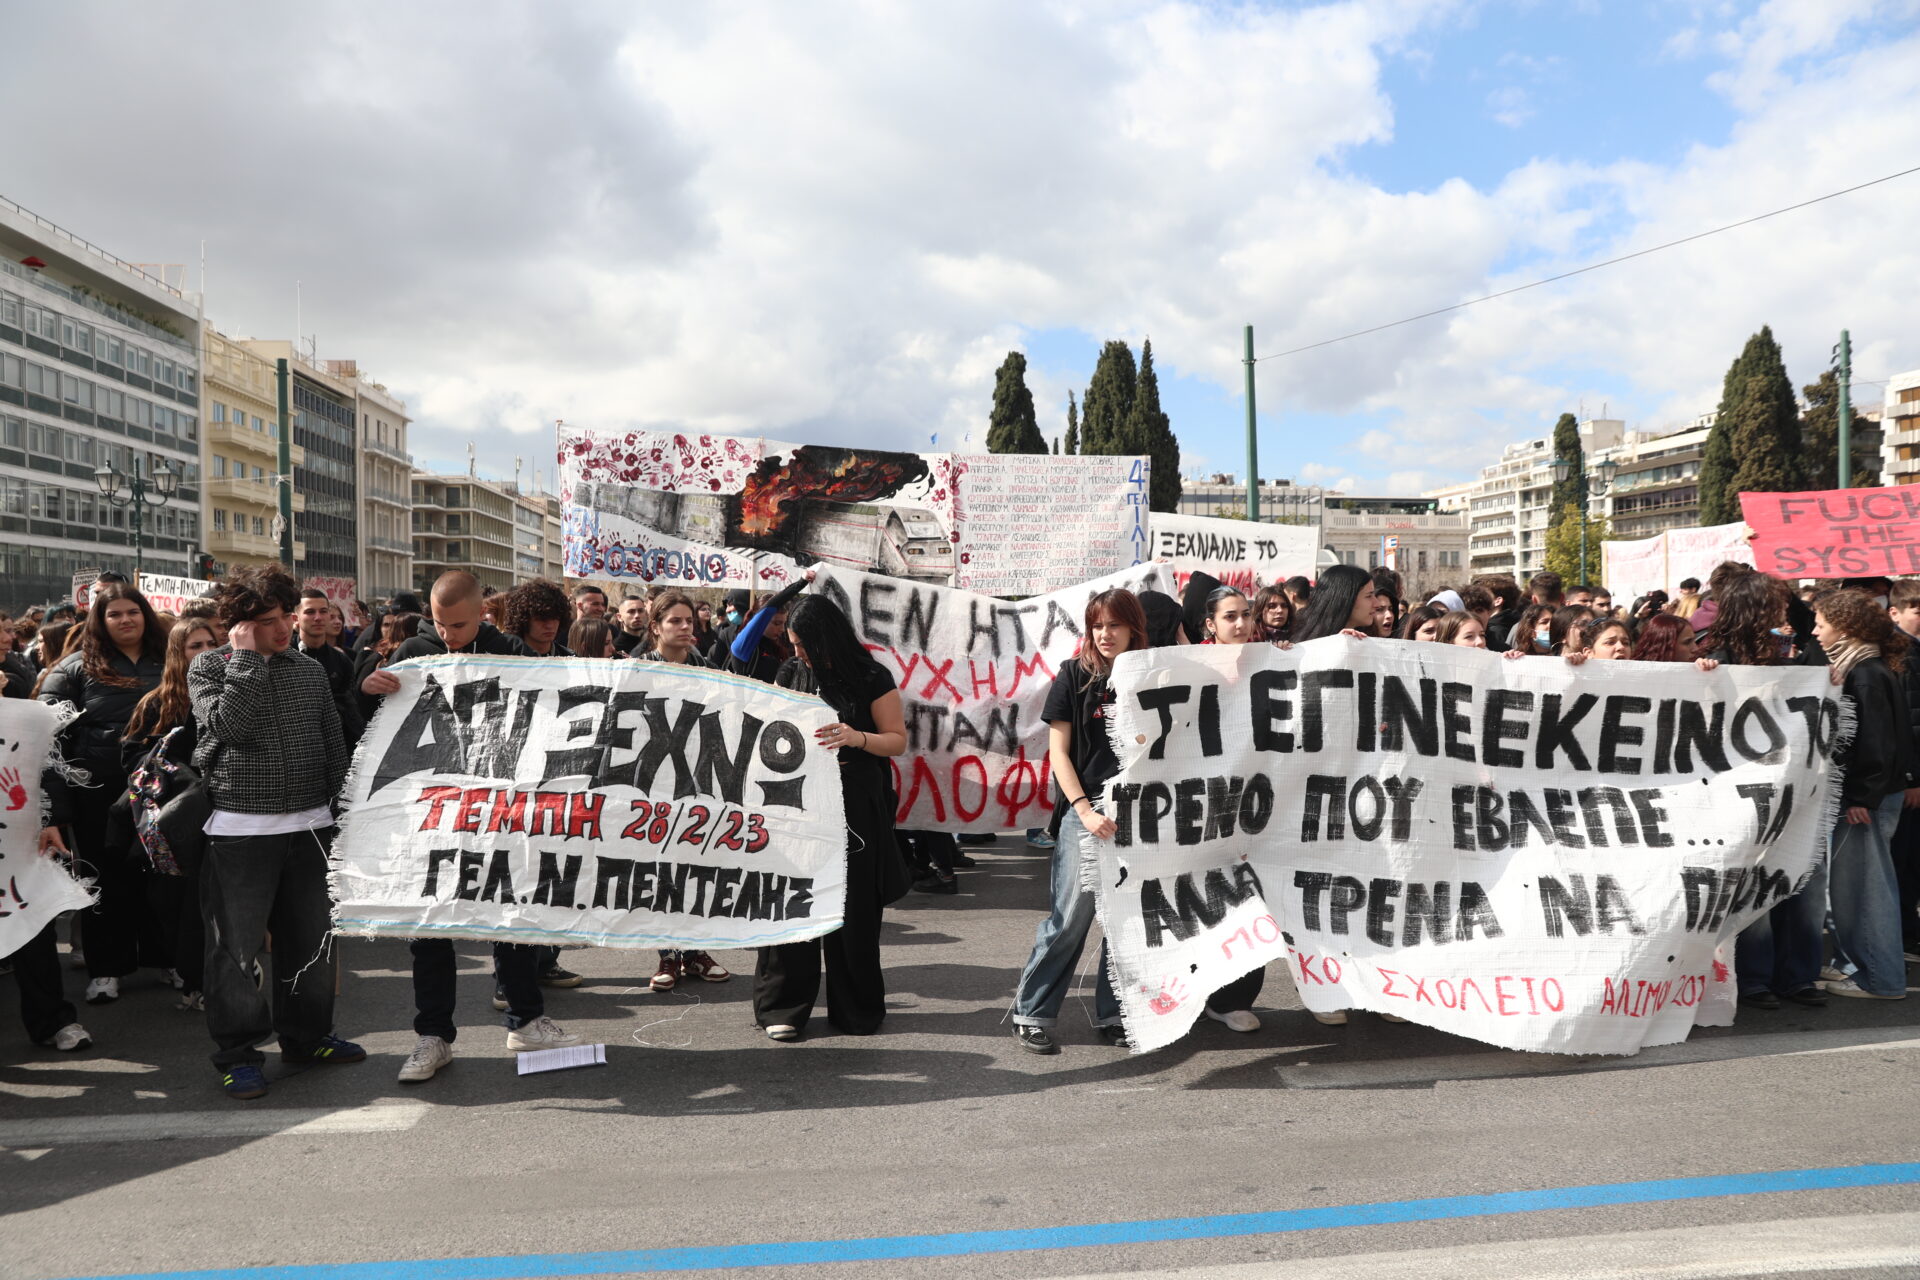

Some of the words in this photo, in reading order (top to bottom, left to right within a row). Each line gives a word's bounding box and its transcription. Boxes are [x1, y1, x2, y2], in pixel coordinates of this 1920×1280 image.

[1127, 493, 1149, 506] ΓΕΛ
[1160, 532, 1246, 561] ΞΕΧΝΑΜΕ
[1254, 539, 1279, 560] ΤΟ
[1829, 522, 1915, 544] THE
[604, 546, 727, 582] ΟΞΥΓΟΝΟ
[966, 588, 1114, 664] ΗΤΑ
[1136, 683, 1222, 760] ΤΙ
[1250, 669, 1476, 763] ΕΓΙΝΕ
[1481, 688, 1788, 774] ΕΚΕΙΝΟ
[417, 785, 607, 843] ΤΕΜΠΗ
[621, 799, 770, 854] 28/2/23
[1111, 772, 1275, 848] ΤΡΕΝΟ
[1300, 773, 1424, 844] ΠΟΥ
[1294, 870, 1506, 947] ΤΡΕΝΑ
[1538, 873, 1646, 939] ΝΑ
[1376, 965, 1565, 1016] ΣΧΟΛΕΙΟ
